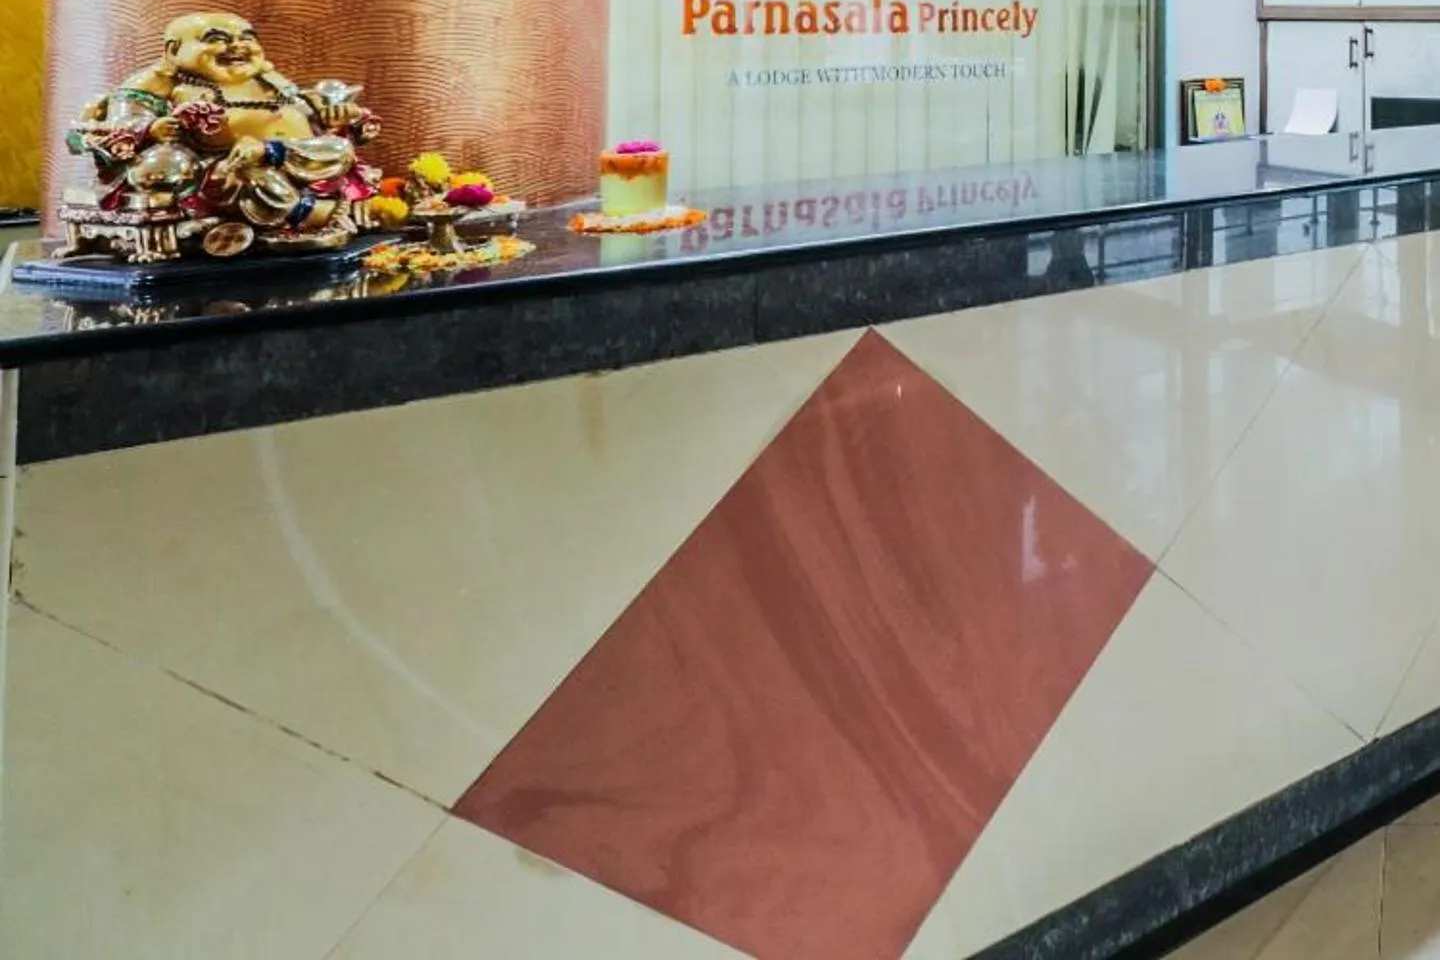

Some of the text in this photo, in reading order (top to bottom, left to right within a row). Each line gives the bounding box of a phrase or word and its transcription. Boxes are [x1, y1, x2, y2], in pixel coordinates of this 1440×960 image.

[917, 0, 1039, 38] Princely
[745, 67, 812, 86] LODGE
[872, 63, 947, 82] MODERN
[949, 62, 1007, 80] TOUCH
